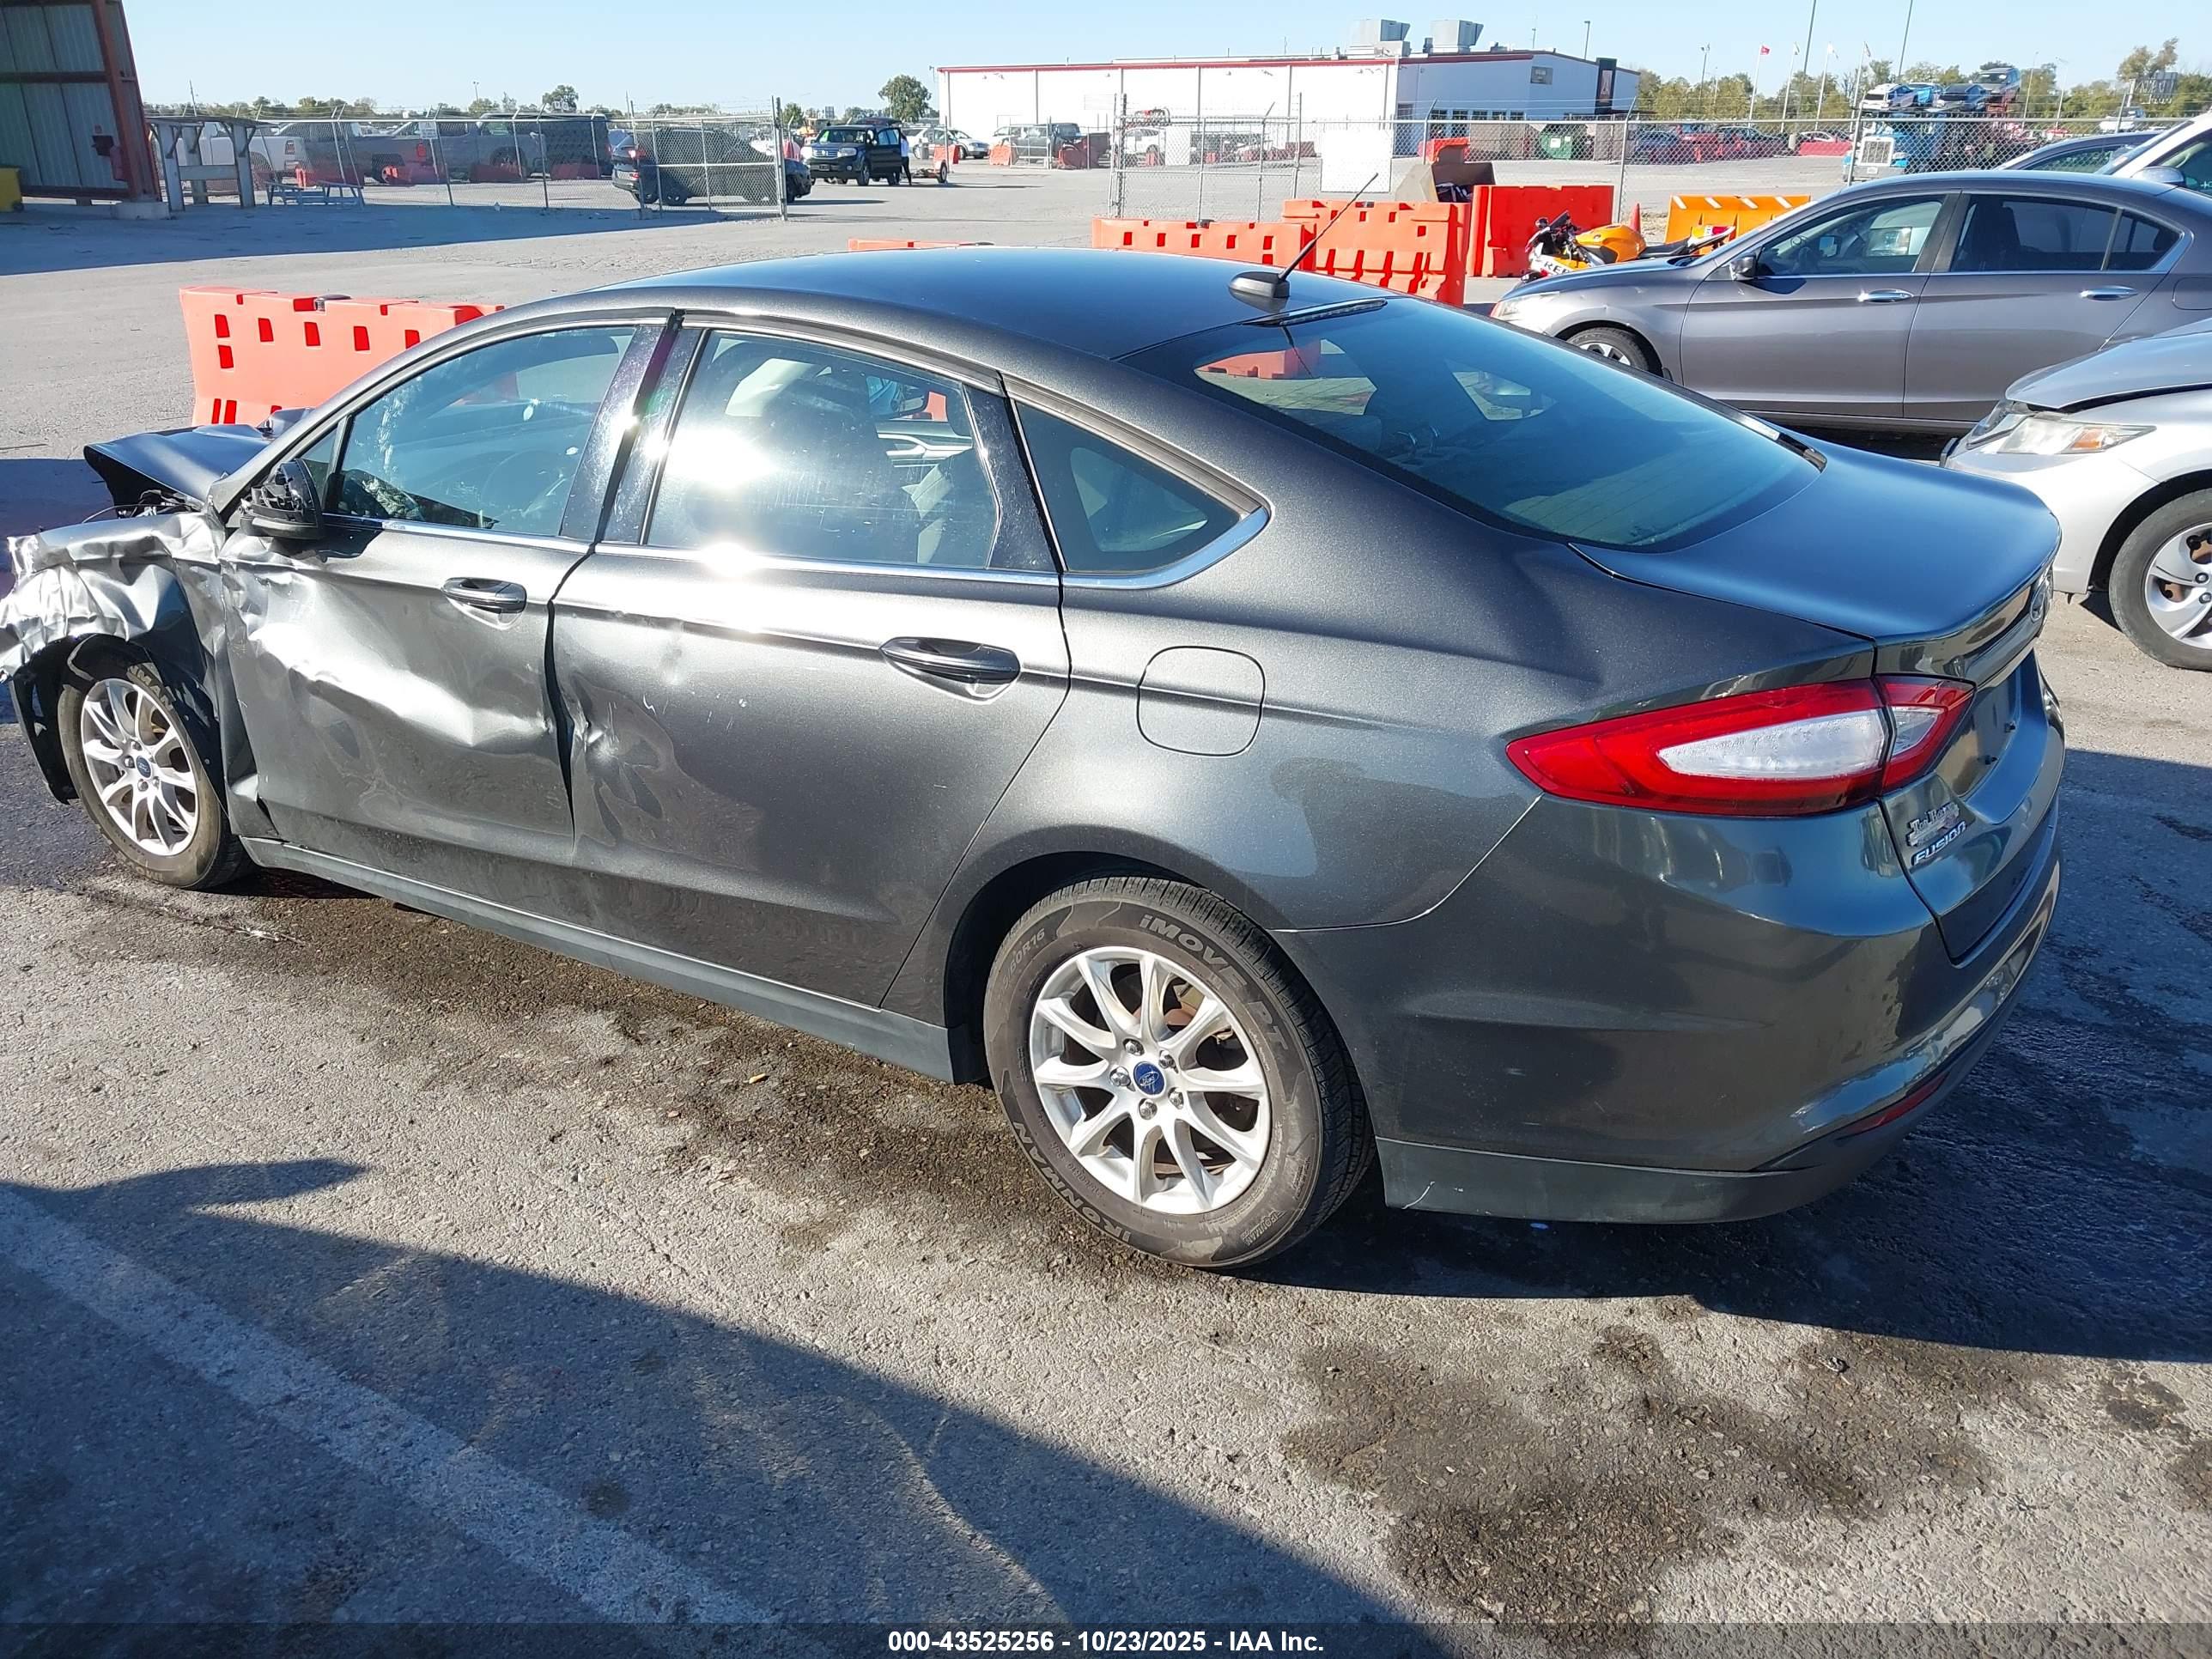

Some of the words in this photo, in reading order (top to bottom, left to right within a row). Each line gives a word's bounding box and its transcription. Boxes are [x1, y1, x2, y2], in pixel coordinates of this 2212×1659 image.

[1913, 820, 1966, 866] FUSION
[1139, 914, 1248, 986] iMOVE
[1012, 1121, 1132, 1242] IRONMAN
